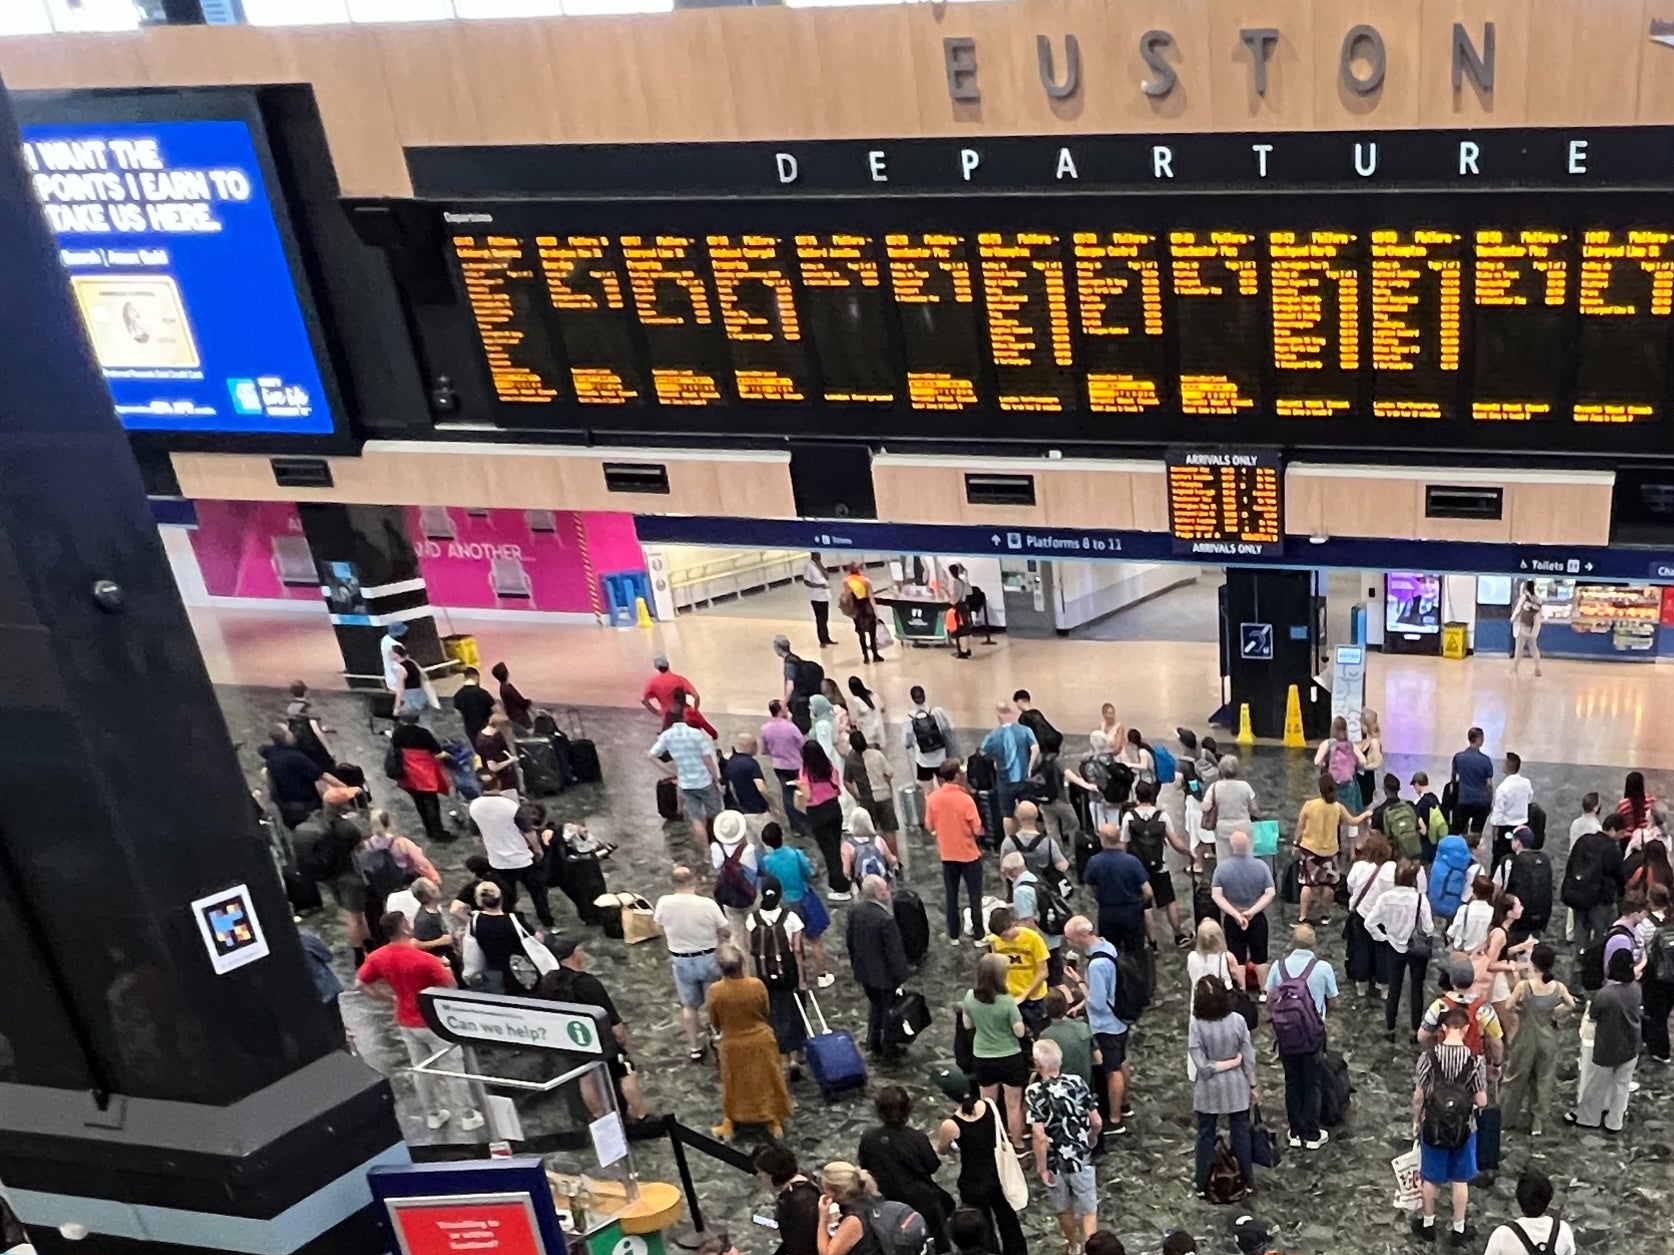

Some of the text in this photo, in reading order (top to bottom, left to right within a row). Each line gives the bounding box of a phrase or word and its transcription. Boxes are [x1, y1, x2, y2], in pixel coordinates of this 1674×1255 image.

[943, 22, 1496, 110] EUSTON
[36, 141, 107, 170] WANT
[109, 140, 163, 170] THE
[33, 173, 123, 202] POINTS
[147, 172, 212, 201] EARN
[212, 170, 250, 201] TO
[45, 204, 222, 233] TAKE US HERE.
[1185, 454, 1258, 466] ARRIVALS ONLY
[1026, 535, 1122, 551] Platforms 8 to 11
[1192, 543, 1263, 555] ARRIVALS ONLY
[1531, 559, 1565, 572] Toilets
[446, 1015, 547, 1043] Can we help?
